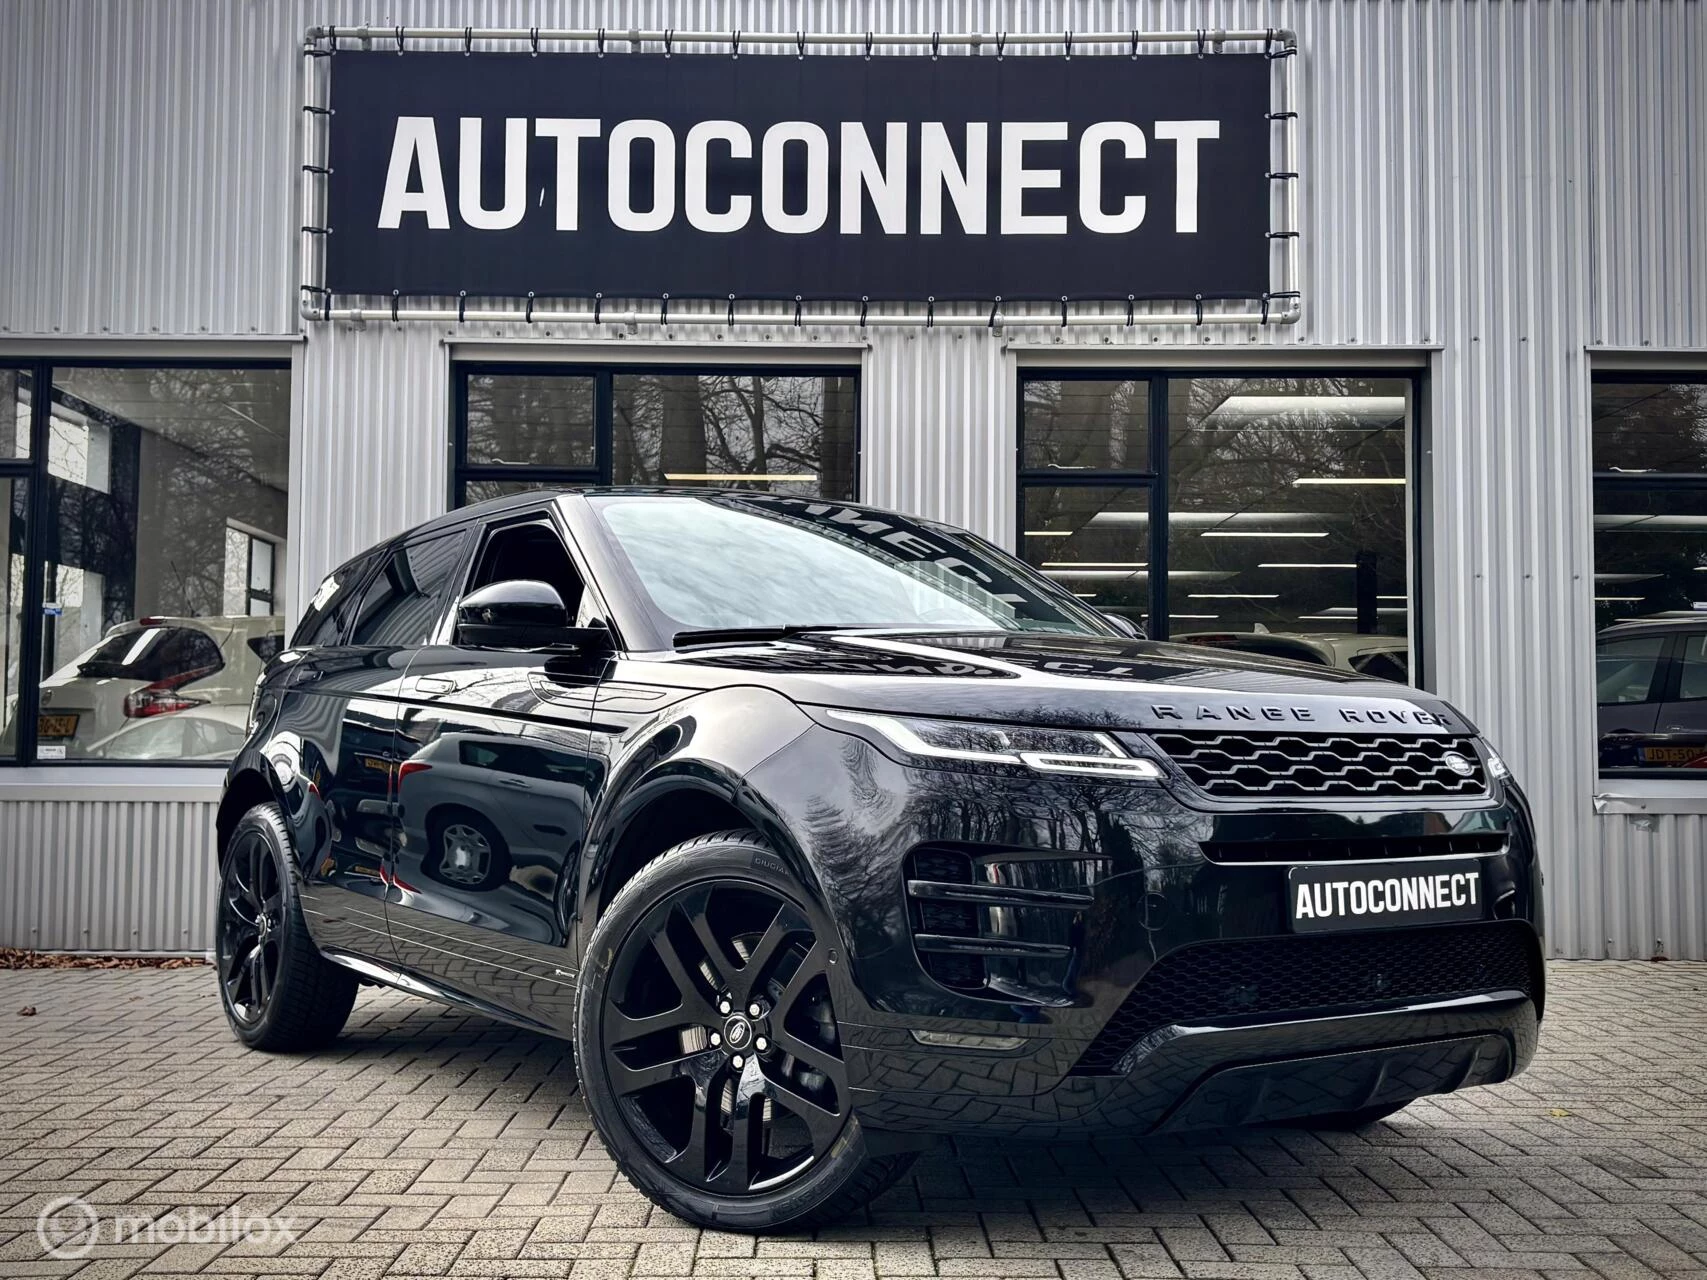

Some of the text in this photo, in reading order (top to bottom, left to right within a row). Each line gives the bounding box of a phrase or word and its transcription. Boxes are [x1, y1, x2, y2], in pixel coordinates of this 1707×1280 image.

[376, 116, 1221, 236] AUTOCONNECT
[1150, 703, 1452, 727] RANGE ROVER
[1295, 872, 1479, 919] AUTOCONNECT
